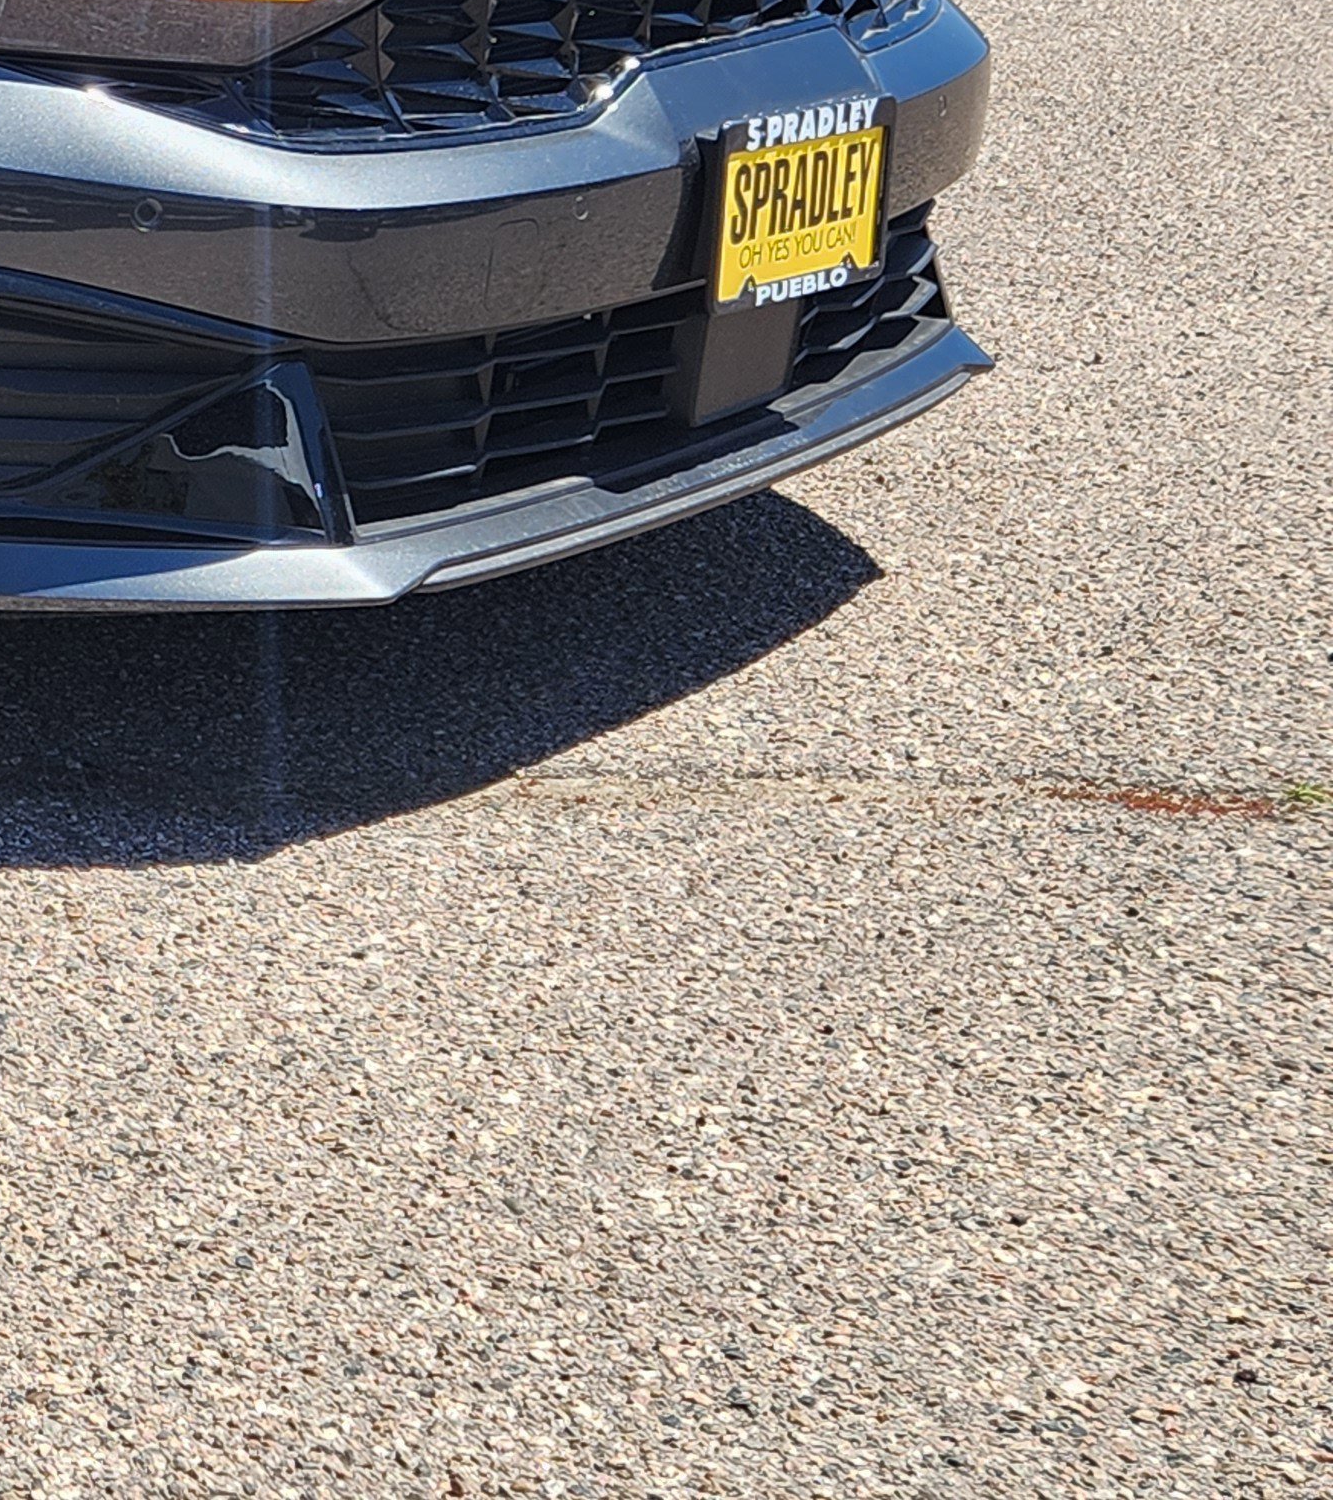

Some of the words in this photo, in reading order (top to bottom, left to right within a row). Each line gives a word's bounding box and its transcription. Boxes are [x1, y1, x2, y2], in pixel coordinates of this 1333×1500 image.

[730, 139, 879, 245] SPRADLEY
[739, 243, 762, 270] OH
[767, 238, 791, 261] YES
[794, 232, 824, 258] YOU
[827, 221, 857, 250] CAN!
[755, 266, 850, 308] PUEBLO
